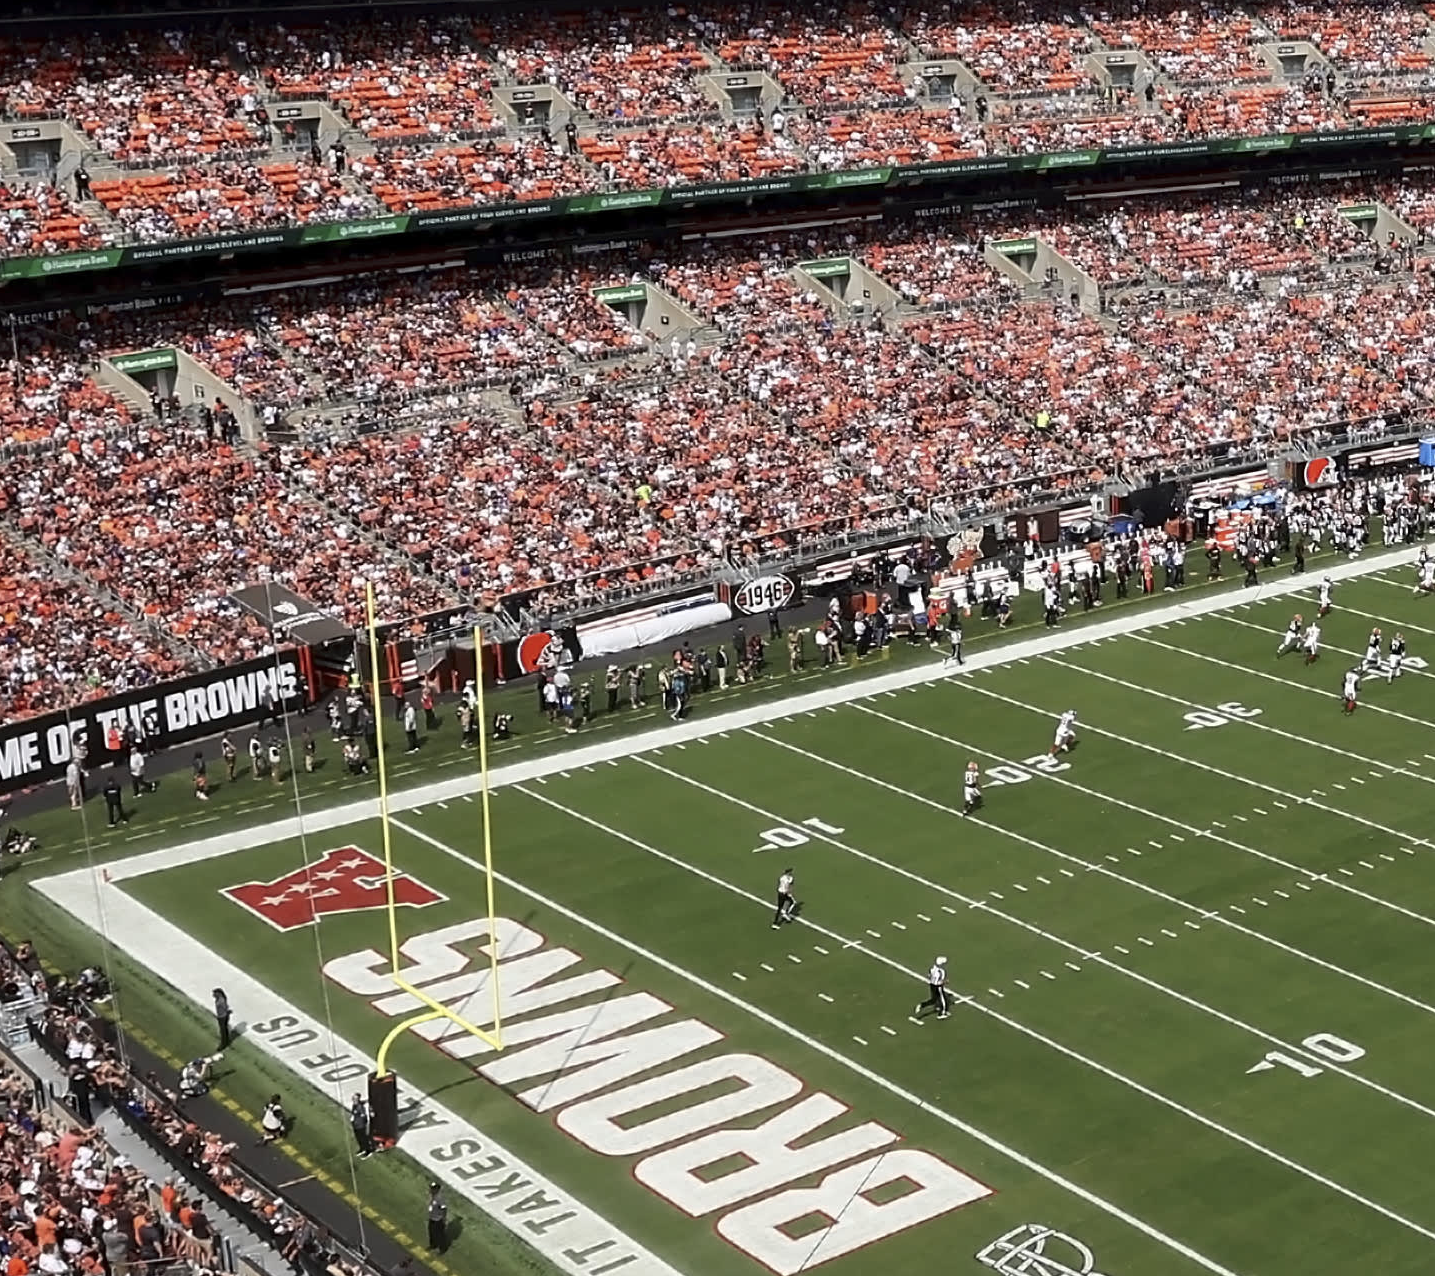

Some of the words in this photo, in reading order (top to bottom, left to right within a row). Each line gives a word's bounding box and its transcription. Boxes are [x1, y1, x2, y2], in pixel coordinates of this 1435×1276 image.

[748, 581, 782, 607] 1946
[165, 662, 297, 732] BROWNS
[1183, 702, 1263, 727] 30
[759, 818, 845, 848] 10
[253, 1013, 317, 1052] US
[311, 1051, 369, 1089] OF
[1265, 1033, 1365, 1077] 10
[428, 1136, 578, 1238] TAKES
